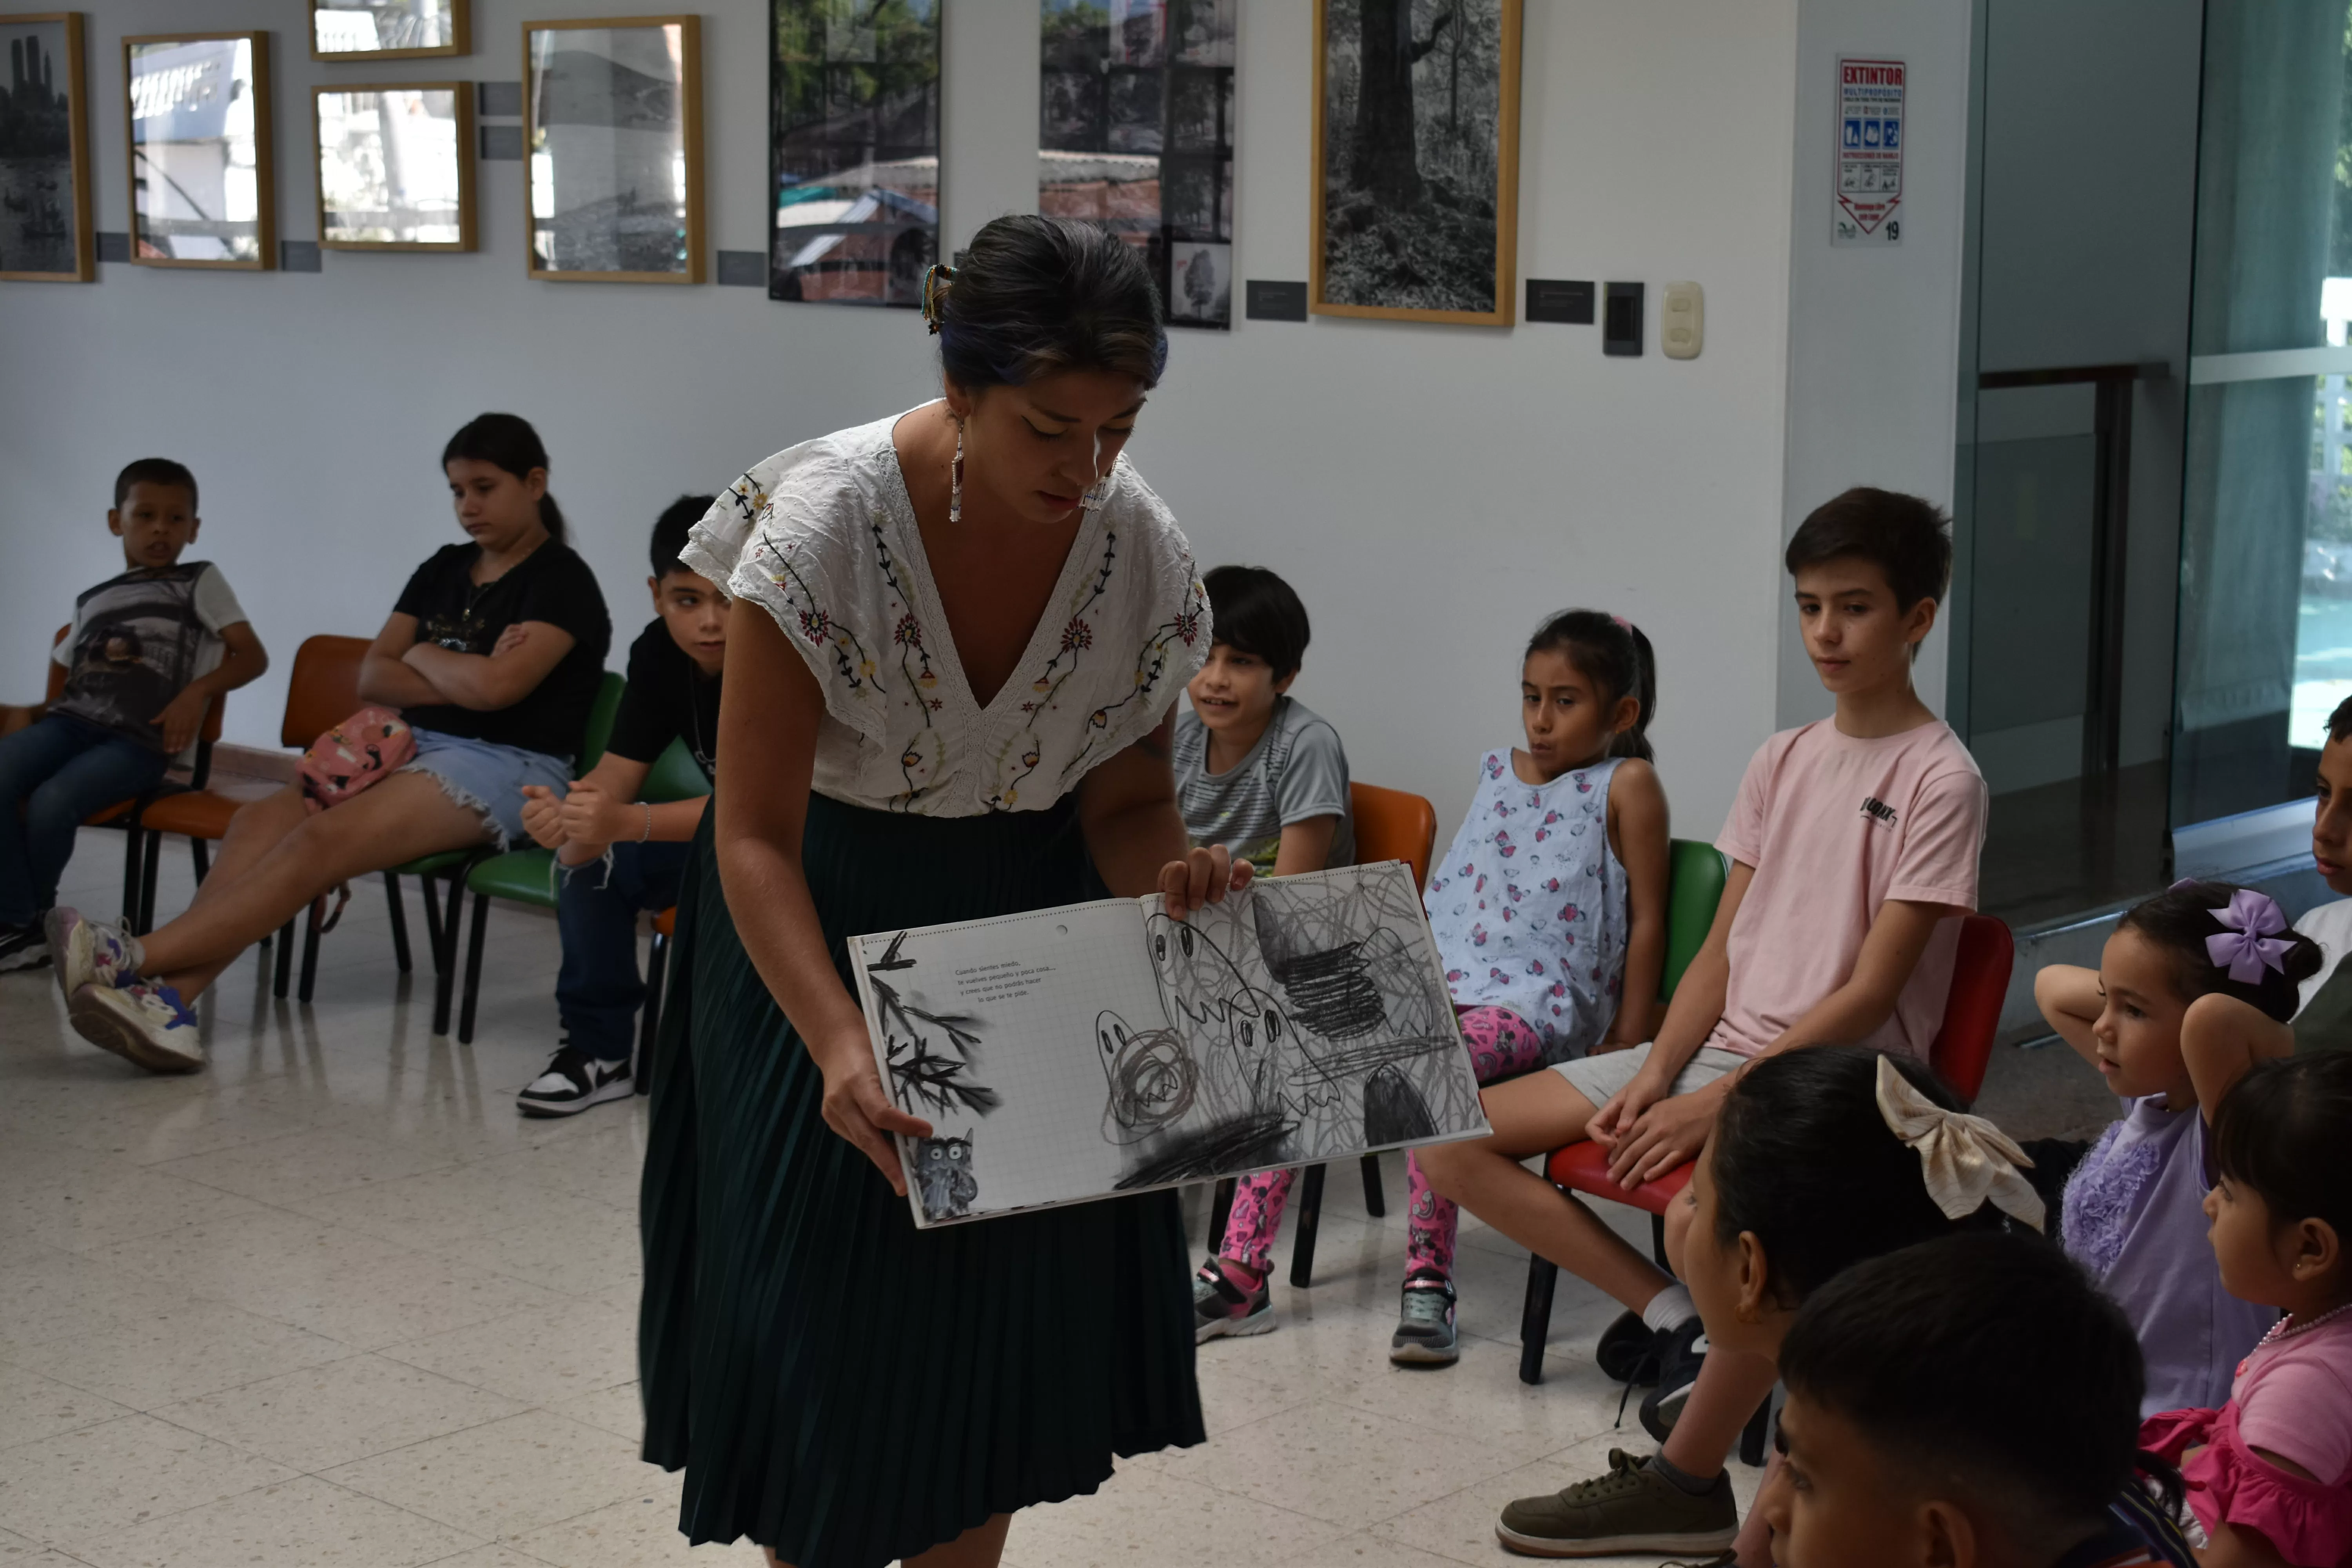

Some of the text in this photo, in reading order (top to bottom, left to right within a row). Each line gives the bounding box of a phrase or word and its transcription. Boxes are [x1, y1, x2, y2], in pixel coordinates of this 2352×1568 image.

[1844, 66, 1902, 86] EXTINTOR
[1885, 220, 1899, 241] 19
[989, 972, 1014, 982] pequeño
[1004, 980, 1024, 989] podrás
